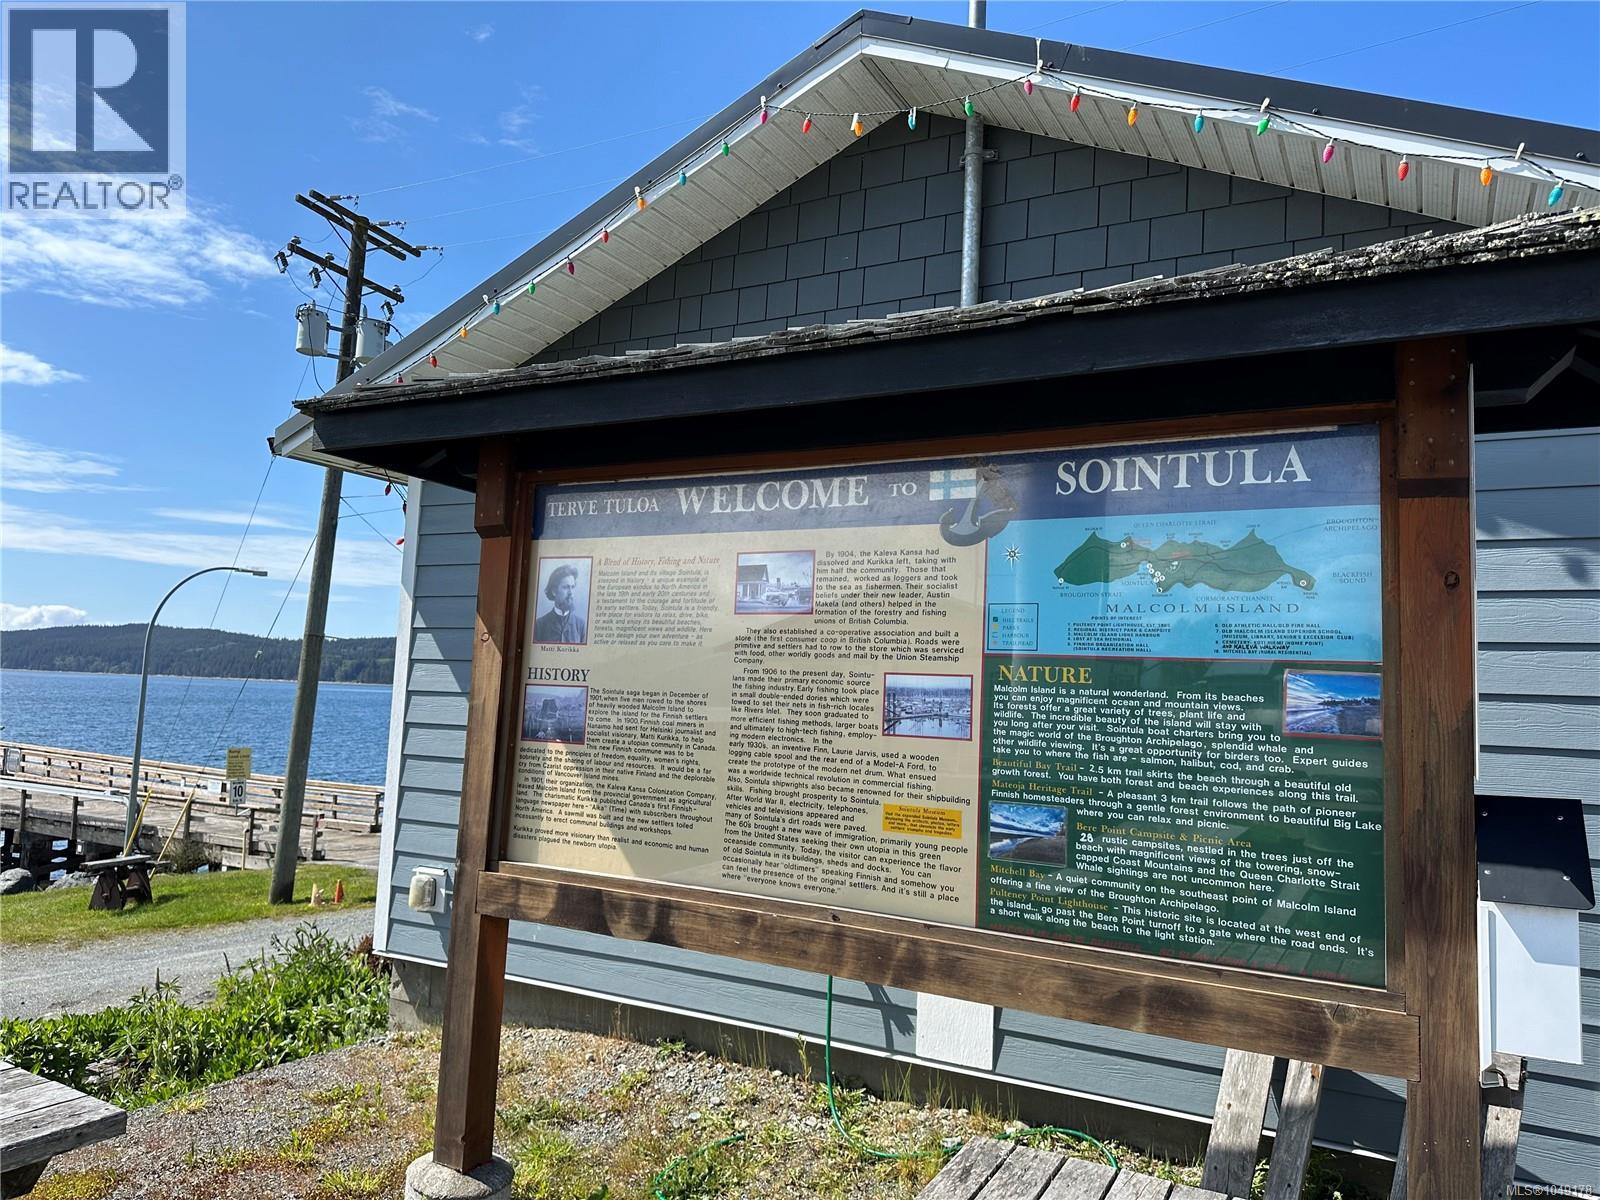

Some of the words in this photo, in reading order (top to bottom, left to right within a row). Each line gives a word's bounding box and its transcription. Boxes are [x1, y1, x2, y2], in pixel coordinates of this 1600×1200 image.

[548, 500, 598, 516] TERVE
[604, 498, 660, 514] TULOA
[676, 476, 869, 515] WELCOME
[889, 481, 918, 498] TO
[1056, 444, 1311, 496] SOINTULA
[1156, 520, 1193, 528] CHARLOTTE
[914, 556, 938, 565] taking
[921, 608, 946, 617] fishing
[1105, 603, 1207, 613] MALCOLM
[1216, 603, 1300, 613] ISLAND
[528, 666, 590, 682] HISTORY
[998, 664, 1092, 684] NATURE
[590, 687, 600, 696] The
[601, 687, 624, 697] Sointula
[993, 684, 1027, 692] Malcolm
[1030, 685, 1056, 693] Island
[1058, 686, 1066, 694] is
[1078, 688, 1109, 697] natural
[1112, 690, 1168, 698] wonderland.
[1176, 690, 1201, 699] From
[1204, 692, 1217, 700] its
[1221, 693, 1264, 702] beaches
[596, 702, 615, 710] heavily
[641, 703, 666, 713] Malcolm
[993, 694, 1008, 703] you
[1029, 695, 1053, 705] enjoy
[1056, 696, 1107, 704] magnificent
[1111, 699, 1140, 707] ocean
[1212, 702, 1243, 711] views.
[1006, 702, 1037, 713] forests
[1039, 703, 1061, 711] offer
[1073, 706, 1096, 714] great
[1099, 707, 1131, 716] variety
[1134, 707, 1144, 715] of
[1148, 708, 1175, 717] trees,
[1179, 710, 1203, 718] plant
[1207, 711, 1222, 719] life
[1226, 712, 1245, 720] and
[730, 716, 746, 725] more
[777, 717, 799, 726] fishing
[835, 721, 856, 729] larger
[233, 786, 243, 797] 10
[748, 786, 772, 796] Fishing
[774, 789, 800, 798] brought
[802, 792, 837, 802] prosperity
[850, 795, 881, 805] Sointula.
[1076, 822, 1097, 833] Bere
[1101, 825, 1126, 834] Point
[1129, 827, 1175, 839] Campsite
[1179, 832, 1187, 841] &
[1192, 834, 1223, 844] Picnic
[1227, 837, 1251, 847] Area
[1080, 833, 1094, 843] 28
[1102, 836, 1127, 845] rustic
[1131, 840, 1183, 851] campsites,
[1186, 845, 1223, 854] nestled
[1227, 847, 1236, 856] in
[1240, 849, 1256, 858] the
[1260, 851, 1287, 861] trees
[1292, 854, 1312, 864] just
[1316, 857, 1331, 865] off
[1336, 858, 1354, 868] the
[762, 869, 794, 878] presence
[820, 877, 846, 886] original
[848, 881, 878, 890] settlers.
[880, 884, 896, 893] And
[937, 893, 959, 902] place
[1076, 863, 1103, 872] Whale
[1106, 867, 1148, 878] sightings
[1190, 877, 1245, 888] uncommon
[1249, 881, 1274, 892] here.
